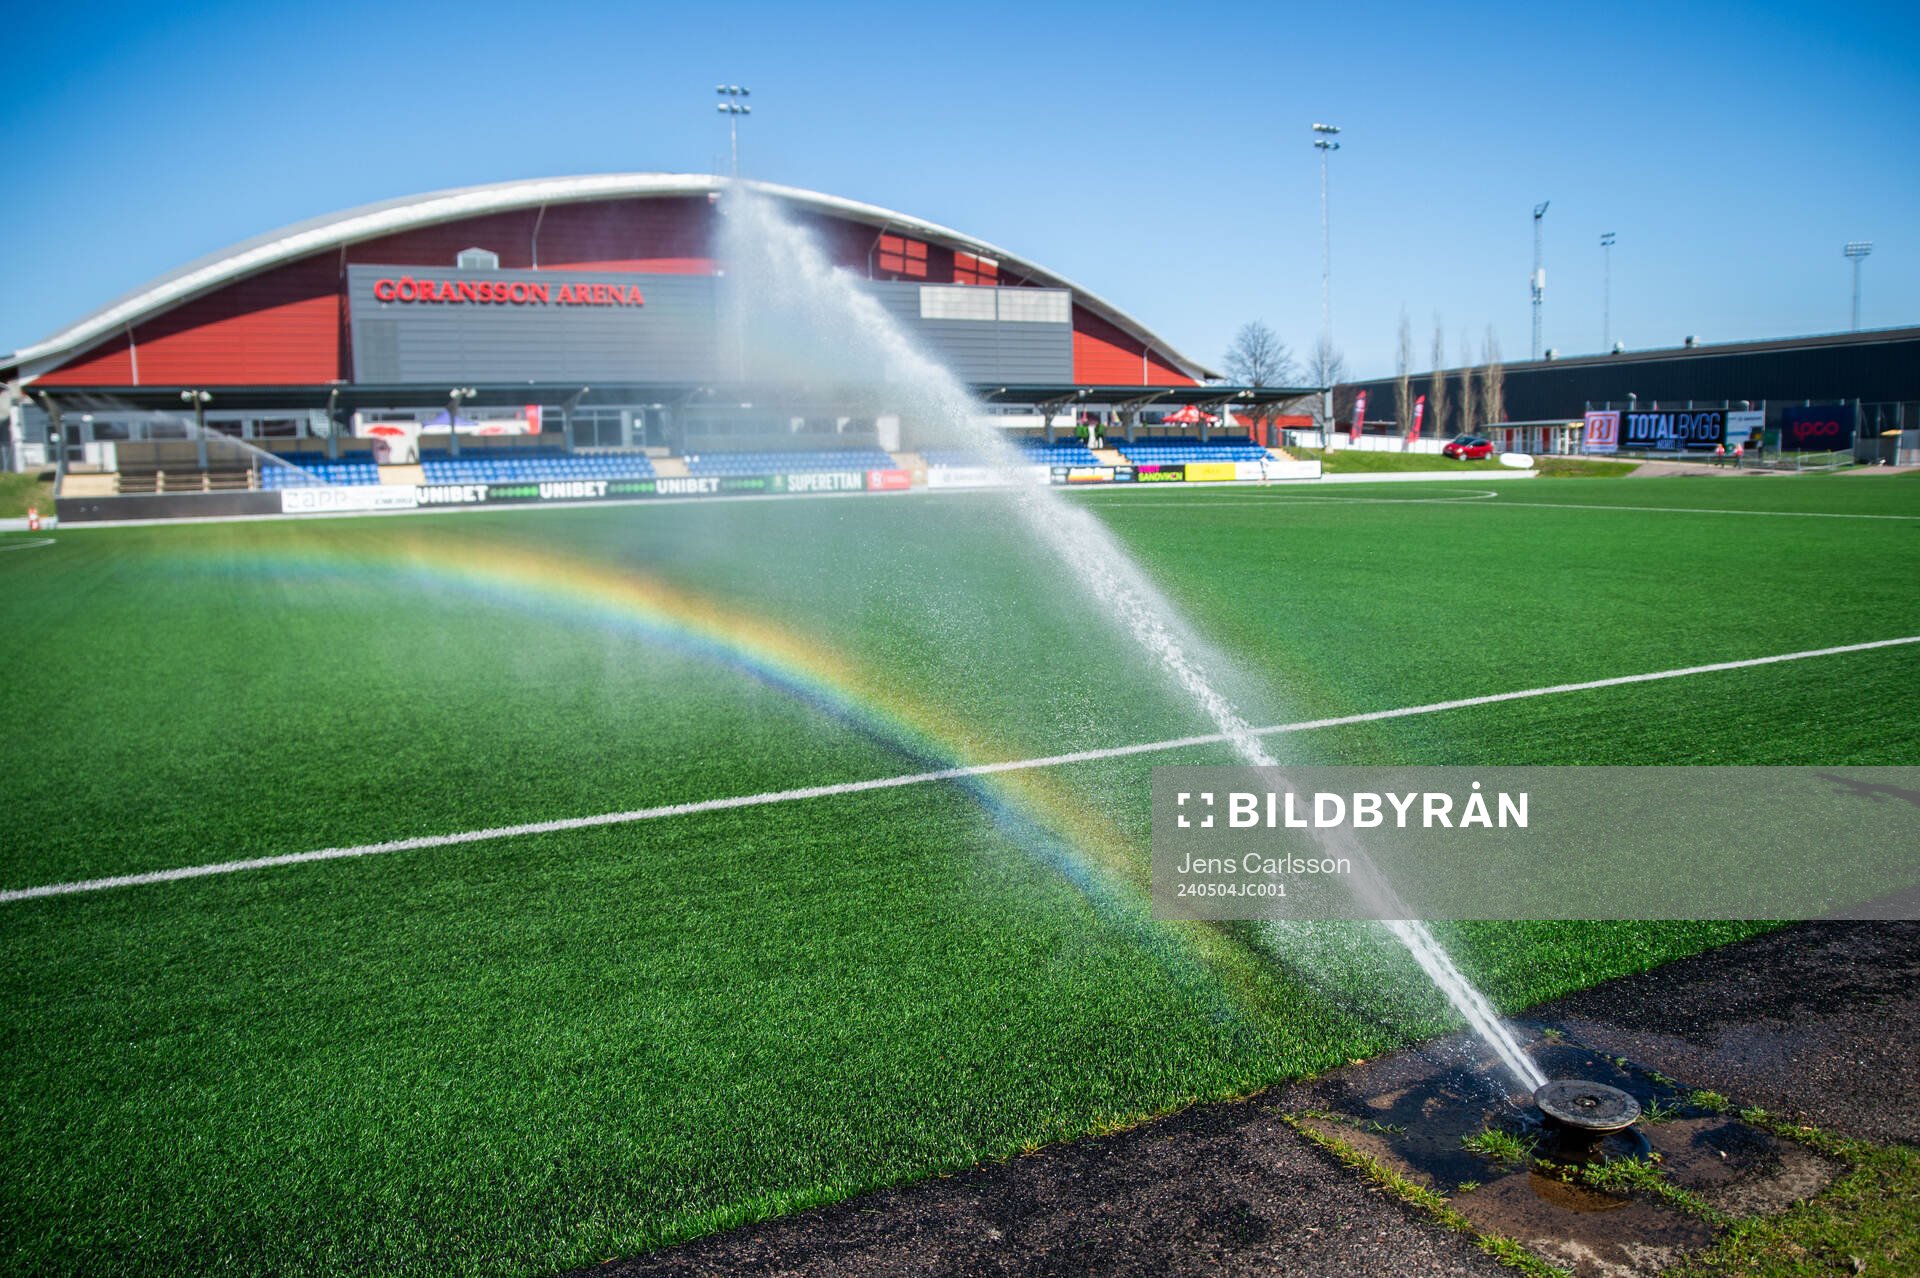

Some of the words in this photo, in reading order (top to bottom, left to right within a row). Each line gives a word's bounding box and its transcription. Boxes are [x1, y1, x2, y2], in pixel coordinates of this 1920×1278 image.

[373, 276, 549, 304] GÖRANSSON
[555, 284, 645, 307] ARENA
[1627, 413, 1720, 440] TOTALBYGG
[539, 481, 608, 499] UNIBET
[656, 478, 720, 494] UNIBET
[787, 472, 862, 491] SUPERETTAN
[416, 485, 488, 504] UNIBET
